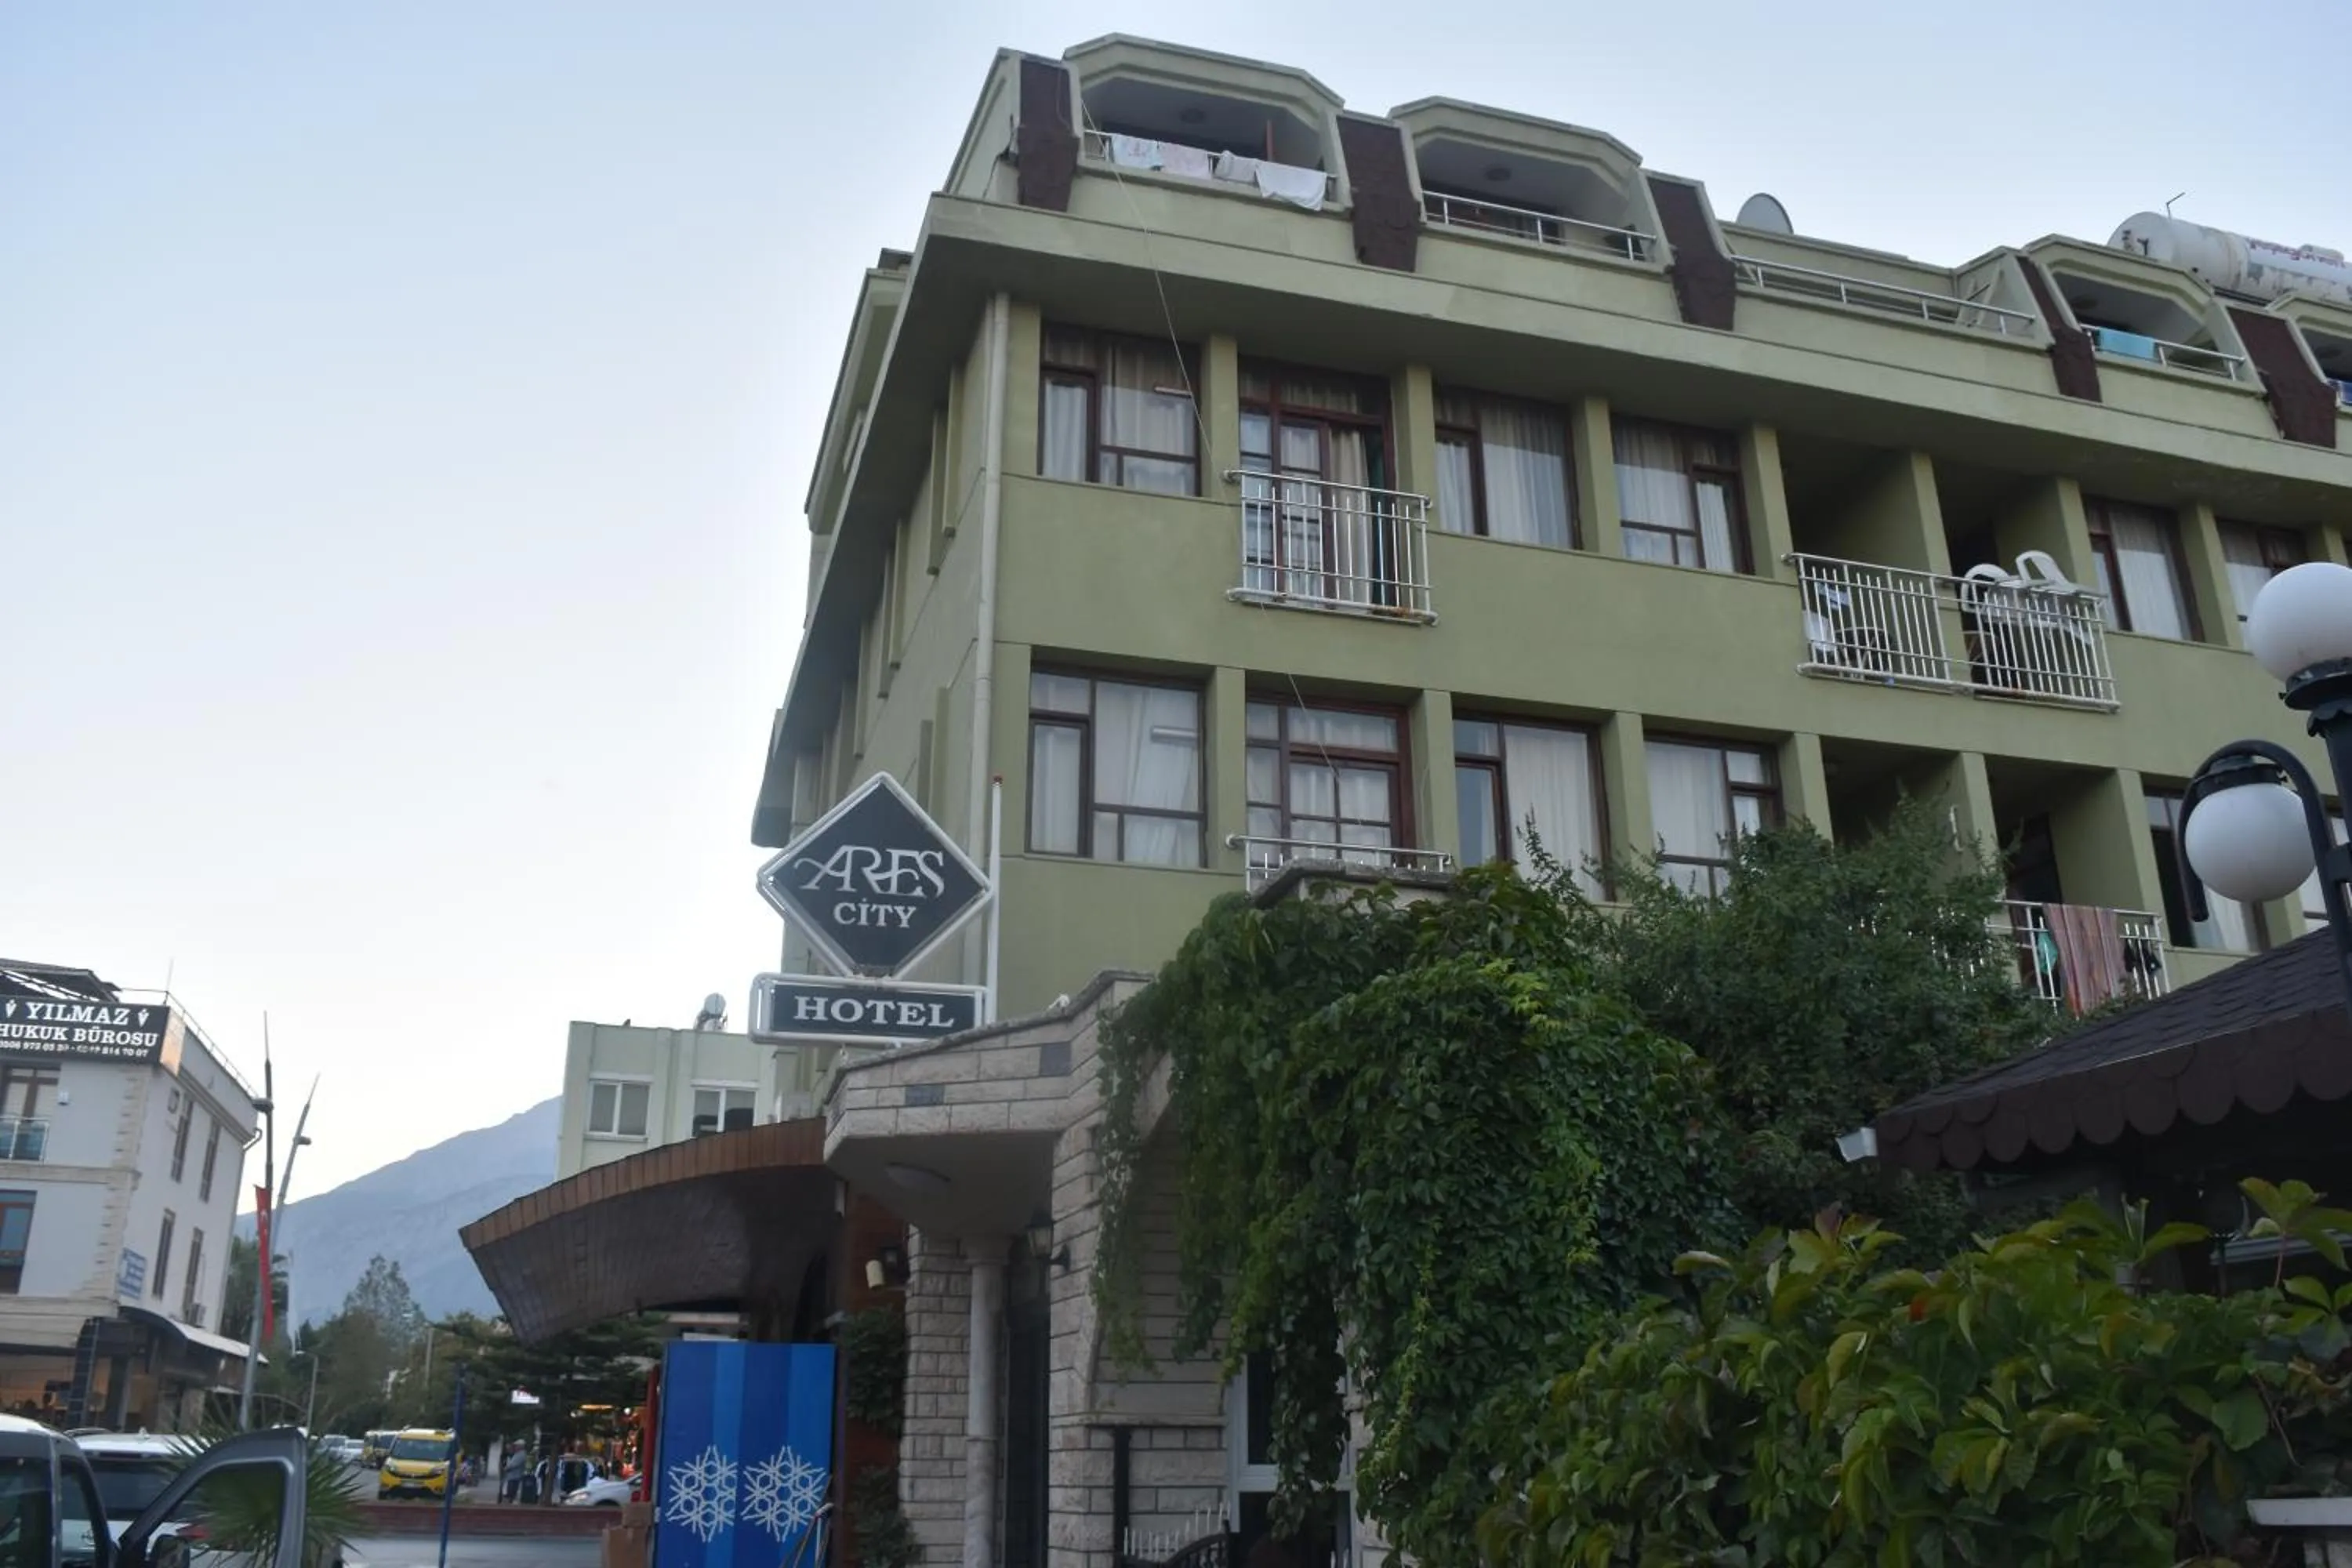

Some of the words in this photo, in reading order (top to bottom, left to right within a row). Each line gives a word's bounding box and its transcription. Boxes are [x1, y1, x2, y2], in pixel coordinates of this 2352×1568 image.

[793, 844, 944, 898] ARES
[25, 1001, 131, 1025] YILMAZ
[793, 996, 954, 1028] HOTEL
[73, 1025, 159, 1047] BÜROSU
